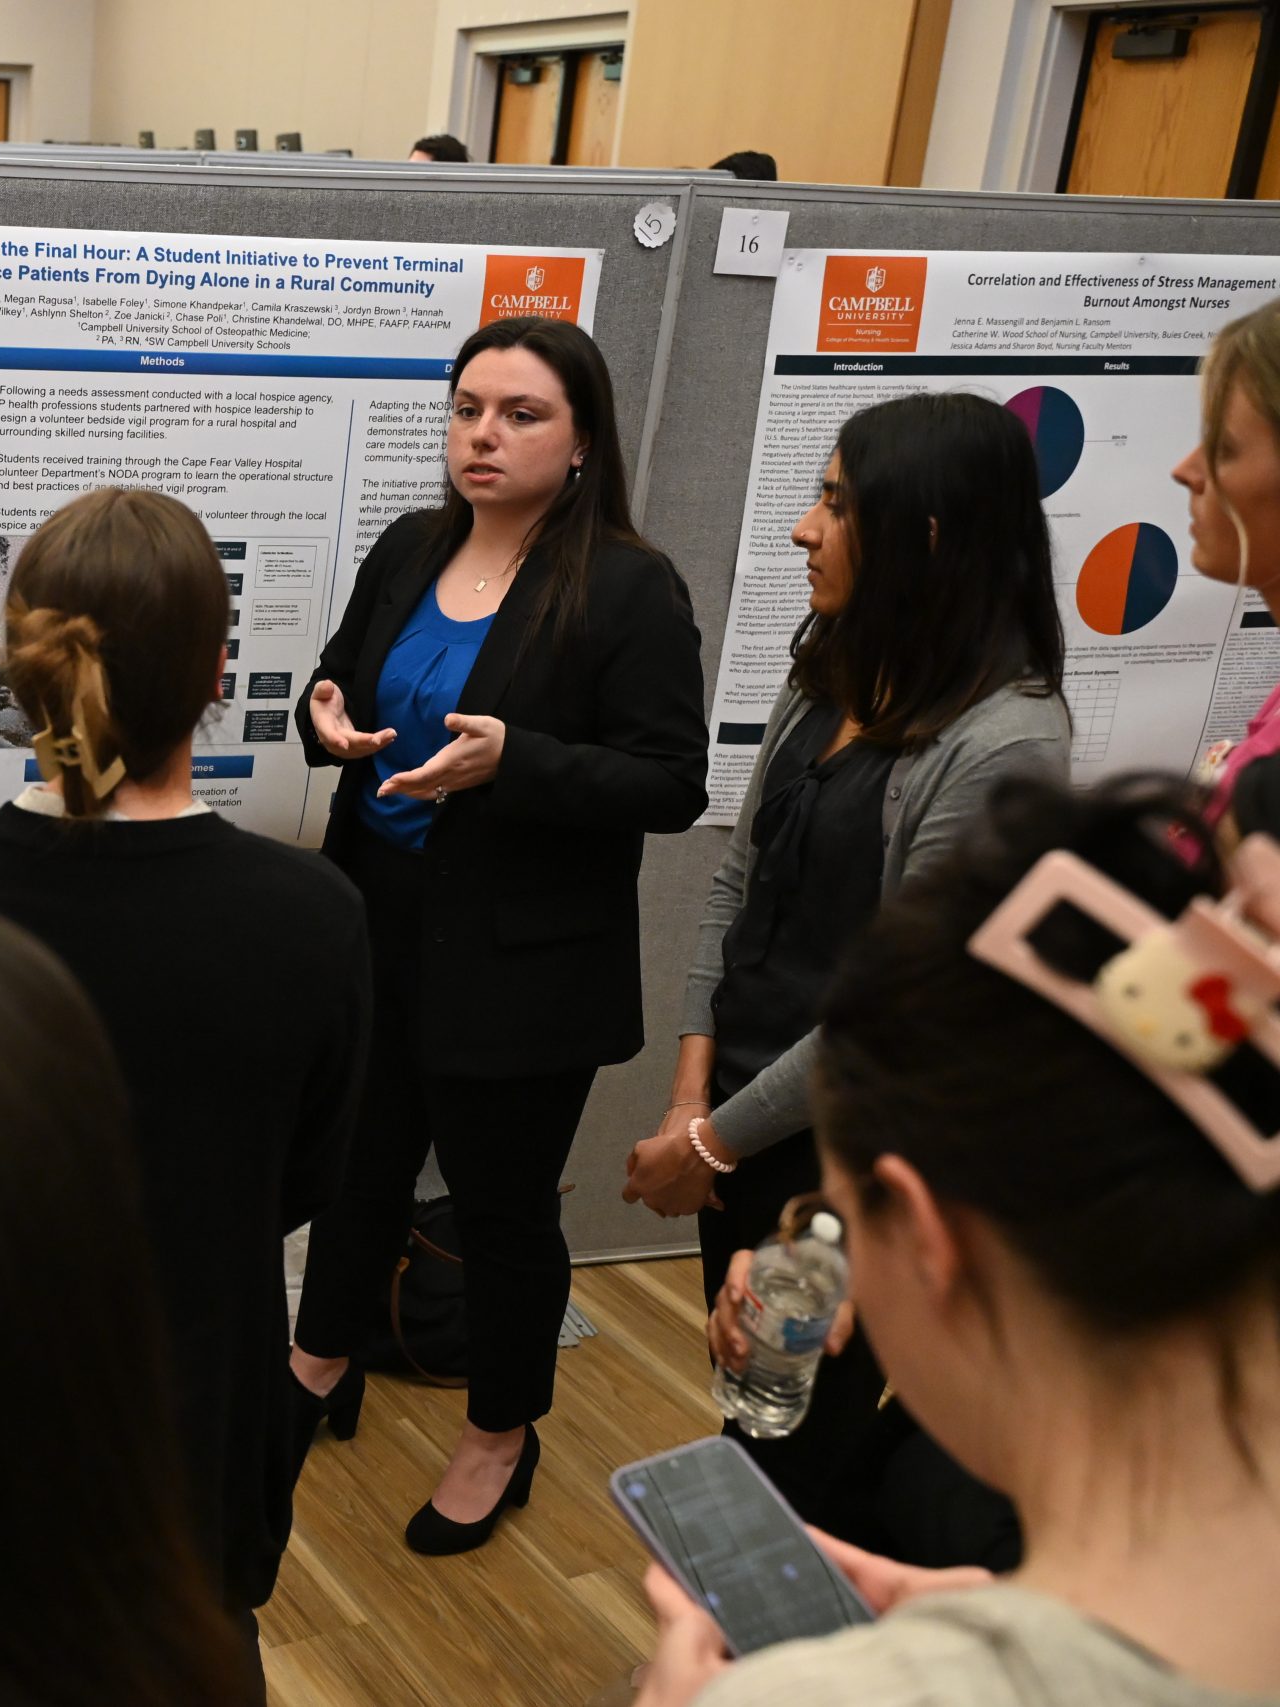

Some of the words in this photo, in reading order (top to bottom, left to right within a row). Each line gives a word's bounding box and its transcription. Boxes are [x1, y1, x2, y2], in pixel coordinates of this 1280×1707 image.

[637, 213, 663, 241] 15
[738, 235, 760, 254] 16
[0, 241, 29, 257] the
[35, 242, 77, 259] Final
[83, 244, 130, 261] Hour:
[136, 246, 149, 262] A
[154, 247, 221, 264] Student
[226, 249, 298, 267] Initiative
[302, 253, 320, 268] to
[325, 253, 388, 271] Prevent
[393, 256, 463, 273] Terminal
[18, 265, 90, 283] Patients
[96, 267, 140, 285] From
[146, 269, 196, 290] Dying
[200, 272, 250, 288] Alone
[255, 273, 270, 289] in
[275, 278, 285, 290] a
[290, 275, 335, 291] Rural
[340, 277, 435, 299] Community
[967, 273, 1036, 286] Correlation
[1038, 274, 1062, 287] and
[1064, 274, 1139, 287] Effectiveness
[1142, 275, 1156, 288] of
[1157, 275, 1194, 288] Stress
[1197, 276, 1277, 292] Management
[4, 294, 36, 306] Megan
[82, 297, 118, 307] Isabelle
[153, 298, 187, 309] Simone
[251, 302, 282, 312] Camila
[342, 306, 372, 317] Jordyn
[410, 307, 444, 317] Hannah
[490, 294, 572, 311] CAMPBELL
[828, 297, 915, 312] CAMPBELL
[1083, 295, 1131, 308] Burnout
[1132, 296, 1187, 311] Amongst
[1189, 296, 1230, 309] Nurses
[30, 308, 66, 319] Ashlynn
[114, 310, 132, 320] Zoe
[175, 312, 204, 322] Chase
[232, 314, 271, 324] Christine
[272, 316, 324, 327] Khandelwal,
[327, 317, 344, 328] DO,
[346, 318, 376, 328] MHPE,
[379, 318, 410, 329] FAAFP,
[412, 319, 451, 329] FAAHPM
[498, 308, 562, 318] UNIVERSITY
[837, 312, 905, 321] UNIVERSITY
[953, 317, 976, 326] Jenna
[985, 317, 1025, 328] Massengill
[1025, 317, 1040, 326] and
[1040, 317, 1074, 328] Benjamin
[1082, 318, 1111, 326] Ransom
[126, 324, 170, 336] University
[172, 324, 202, 335] School
[204, 326, 214, 335] of
[215, 326, 268, 337] Osteopathic
[269, 328, 310, 339] Medicine;
[855, 328, 882, 337] Nursing
[952, 330, 989, 338] Catherine
[990, 330, 1000, 338] W.
[1002, 330, 1025, 339] Wood
[1025, 330, 1049, 339] School
[1049, 329, 1059, 338] of
[1058, 330, 1088, 341] Nursing,
[1089, 330, 1123, 340] Campbell
[1123, 330, 1160, 340] University,
[1182, 330, 1209, 340] Creek,
[950, 342, 973, 350] Jessica
[974, 342, 997, 350] Adams
[998, 342, 1012, 350] and
[1012, 342, 1035, 350] Sharon
[1036, 342, 1054, 351] Boyd,
[1055, 342, 1081, 351] Nursing
[1081, 342, 1105, 351] Faculty
[1105, 342, 1132, 350] Mentors
[140, 355, 185, 366] Methods
[833, 362, 883, 371] Introduction
[1104, 362, 1130, 370] Results
[58, 387, 88, 397] needs
[90, 389, 149, 398] assessment
[151, 389, 202, 400] conducted
[204, 390, 223, 400] with
[226, 392, 232, 400] a
[235, 391, 257, 401] local
[259, 392, 296, 403] hospice
[298, 394, 333, 405] agency,
[368, 413, 403, 423] realities
[405, 413, 415, 423] of
[416, 416, 423, 424] a
[425, 415, 445, 424] rural
[366, 427, 428, 437] demonstrates
[42, 455, 84, 465] received
[86, 456, 122, 467] training
[125, 456, 161, 468] through
[164, 456, 179, 466] the
[181, 457, 207, 468] Cape
[209, 457, 232, 467] Fear
[234, 458, 262, 470] Valley
[264, 458, 302, 470] Hospital
